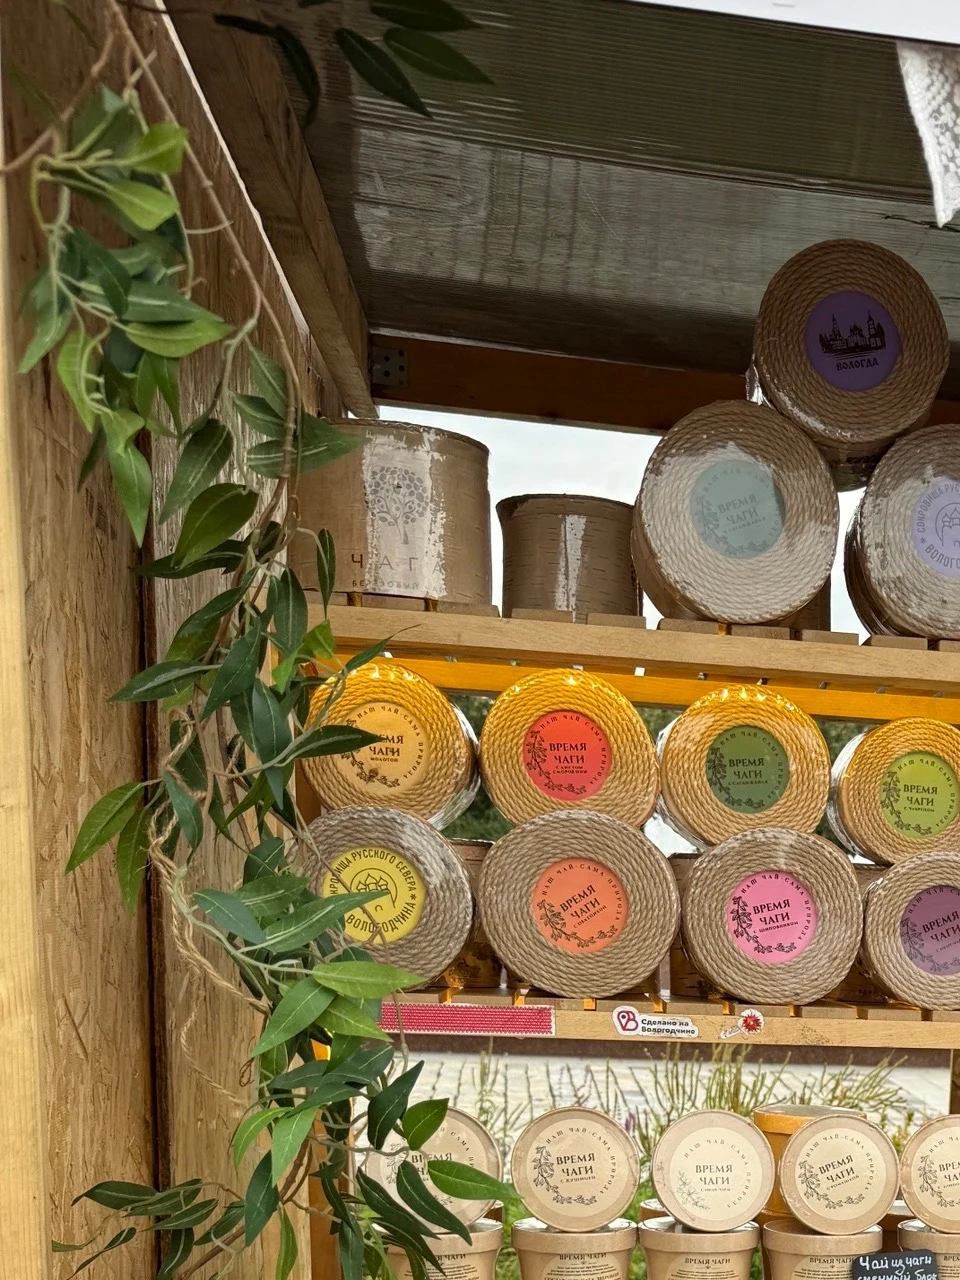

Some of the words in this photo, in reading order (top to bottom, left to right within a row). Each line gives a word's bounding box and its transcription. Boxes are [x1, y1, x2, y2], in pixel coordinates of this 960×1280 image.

[836, 357, 879, 371] ВОЛОГДА
[717, 493, 757, 514] ВРЕМЯ
[726, 507, 758, 525] ЧАГИ
[357, 706, 376, 719] НАШ
[381, 706, 399, 714] ЧАЙ
[403, 714, 421, 737] САМА
[368, 746, 400, 757] ЧАГИ
[549, 742, 587, 752] ВРЕМЯ
[554, 755, 585, 764] ЧАГИ
[728, 757, 765, 768] ВРЕМЯ
[897, 760, 915, 771] НАШ
[733, 770, 763, 779] ЧАГИ
[903, 784, 938, 795] ВРЕМЯ
[906, 796, 934, 807] ЧАГИ
[351, 849, 397, 864] РУССКОГО
[395, 861, 417, 892] СЕВЕРА
[542, 877, 555, 896] НАШ
[741, 878, 757, 894] НАШ
[784, 877, 804, 896] САМА
[560, 884, 596, 912] ВРЕМЯ
[570, 897, 601, 919] ЧАГИ
[752, 899, 791, 915] ВРЕМЯ
[346, 902, 417, 934] ВОЛООДЧИНА
[759, 912, 790, 926] ЧАГИ
[922, 910, 960, 933] ВРЕМЯ
[930, 924, 960, 942] ЧАГИ
[641, 1018, 677, 1027] Сделано
[641, 1026, 696, 1035] Вологодчине
[556, 1153, 595, 1165] ВРЕМЯ
[818, 1154, 854, 1175] ВРЕМЯ
[562, 1165, 594, 1177] ЧАГИ
[695, 1164, 733, 1173] ВРЕМЯ
[826, 1166, 855, 1183] ЧАГИ
[699, 1176, 730, 1185] ЧАГИ
[586, 1252, 607, 1260] ЧАГИ
[684, 1257, 710, 1265] ВРЕМЯ
[711, 1257, 731, 1265] ЧАГИ
[809, 1257, 835, 1265] ВРЕМЯ
[859, 1256, 889, 1271] Чай
[891, 1258, 906, 1276] из
[905, 1256, 932, 1268] чаги
